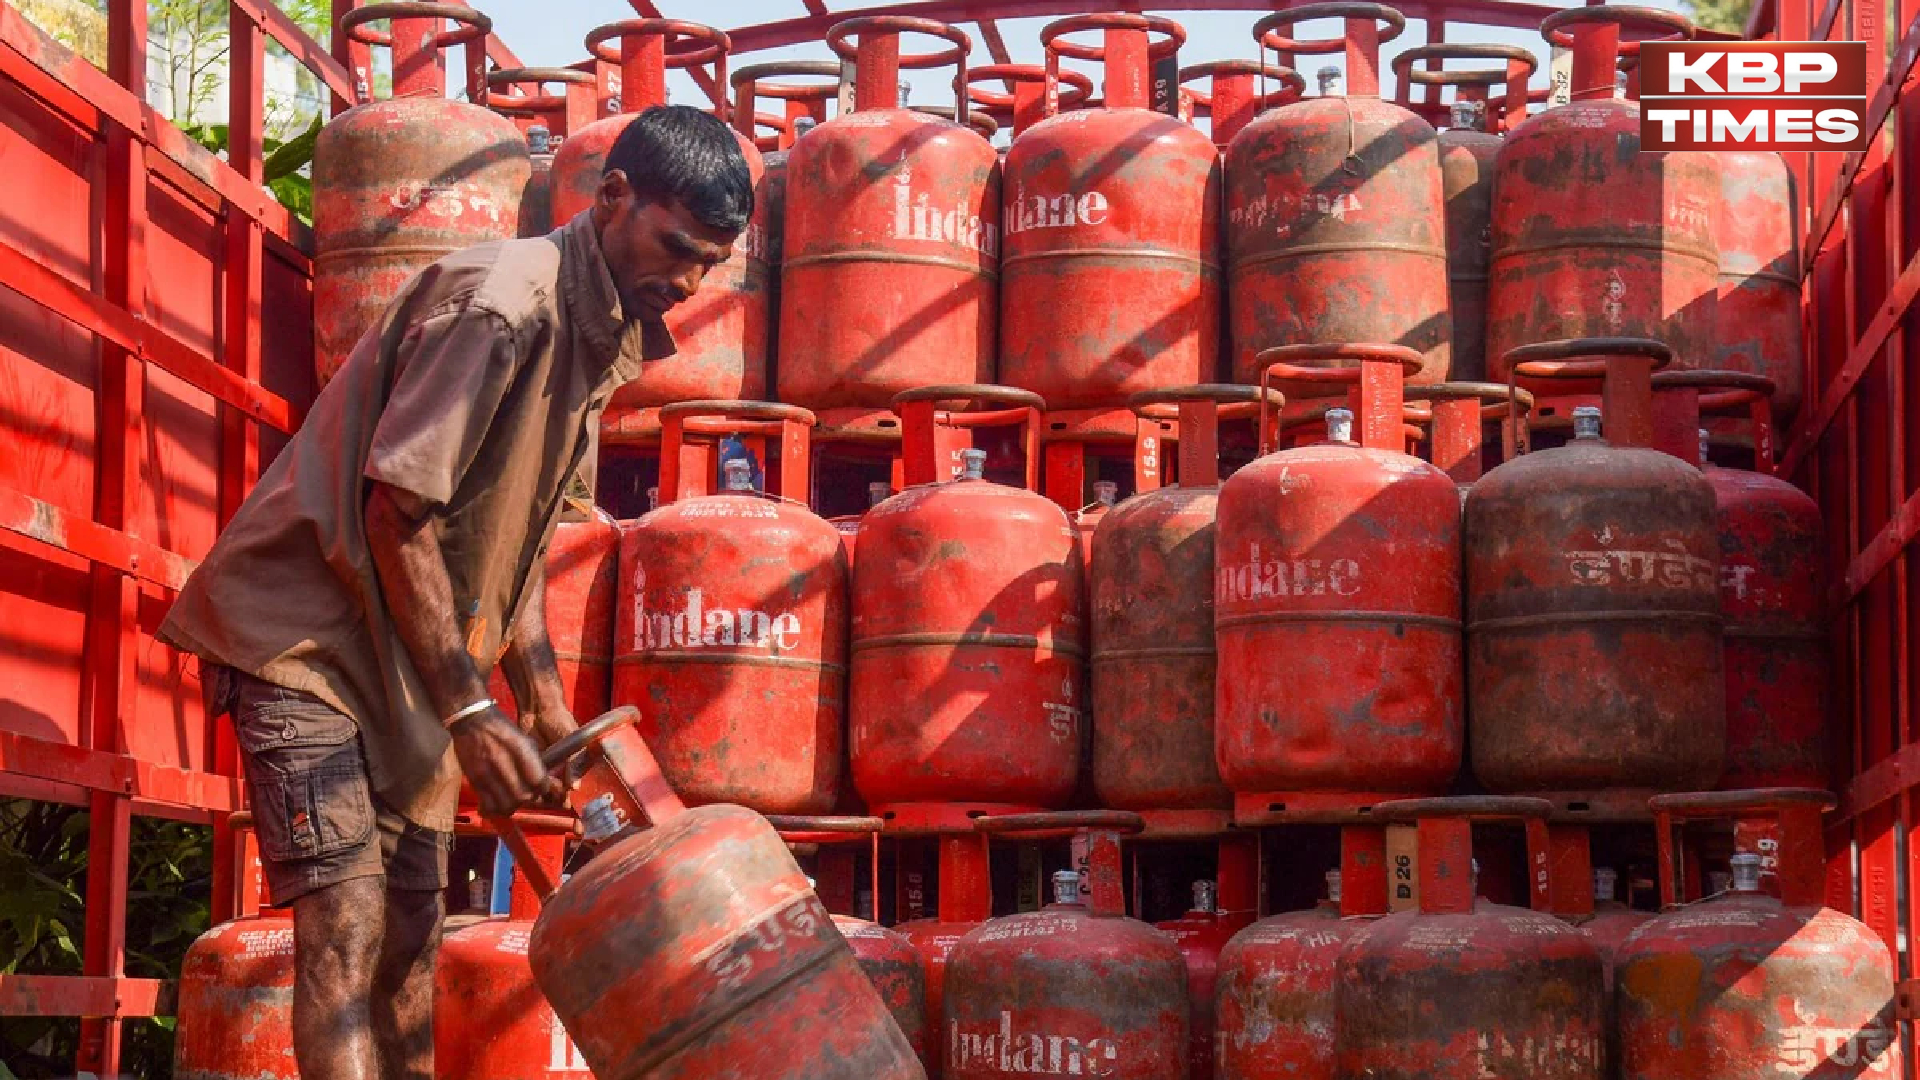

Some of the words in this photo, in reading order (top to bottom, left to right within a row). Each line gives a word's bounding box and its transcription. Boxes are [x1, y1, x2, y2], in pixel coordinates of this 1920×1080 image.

[1218, 543, 1361, 603] ndane
[632, 586, 800, 651] Indane
[1396, 854, 1410, 880] 26
